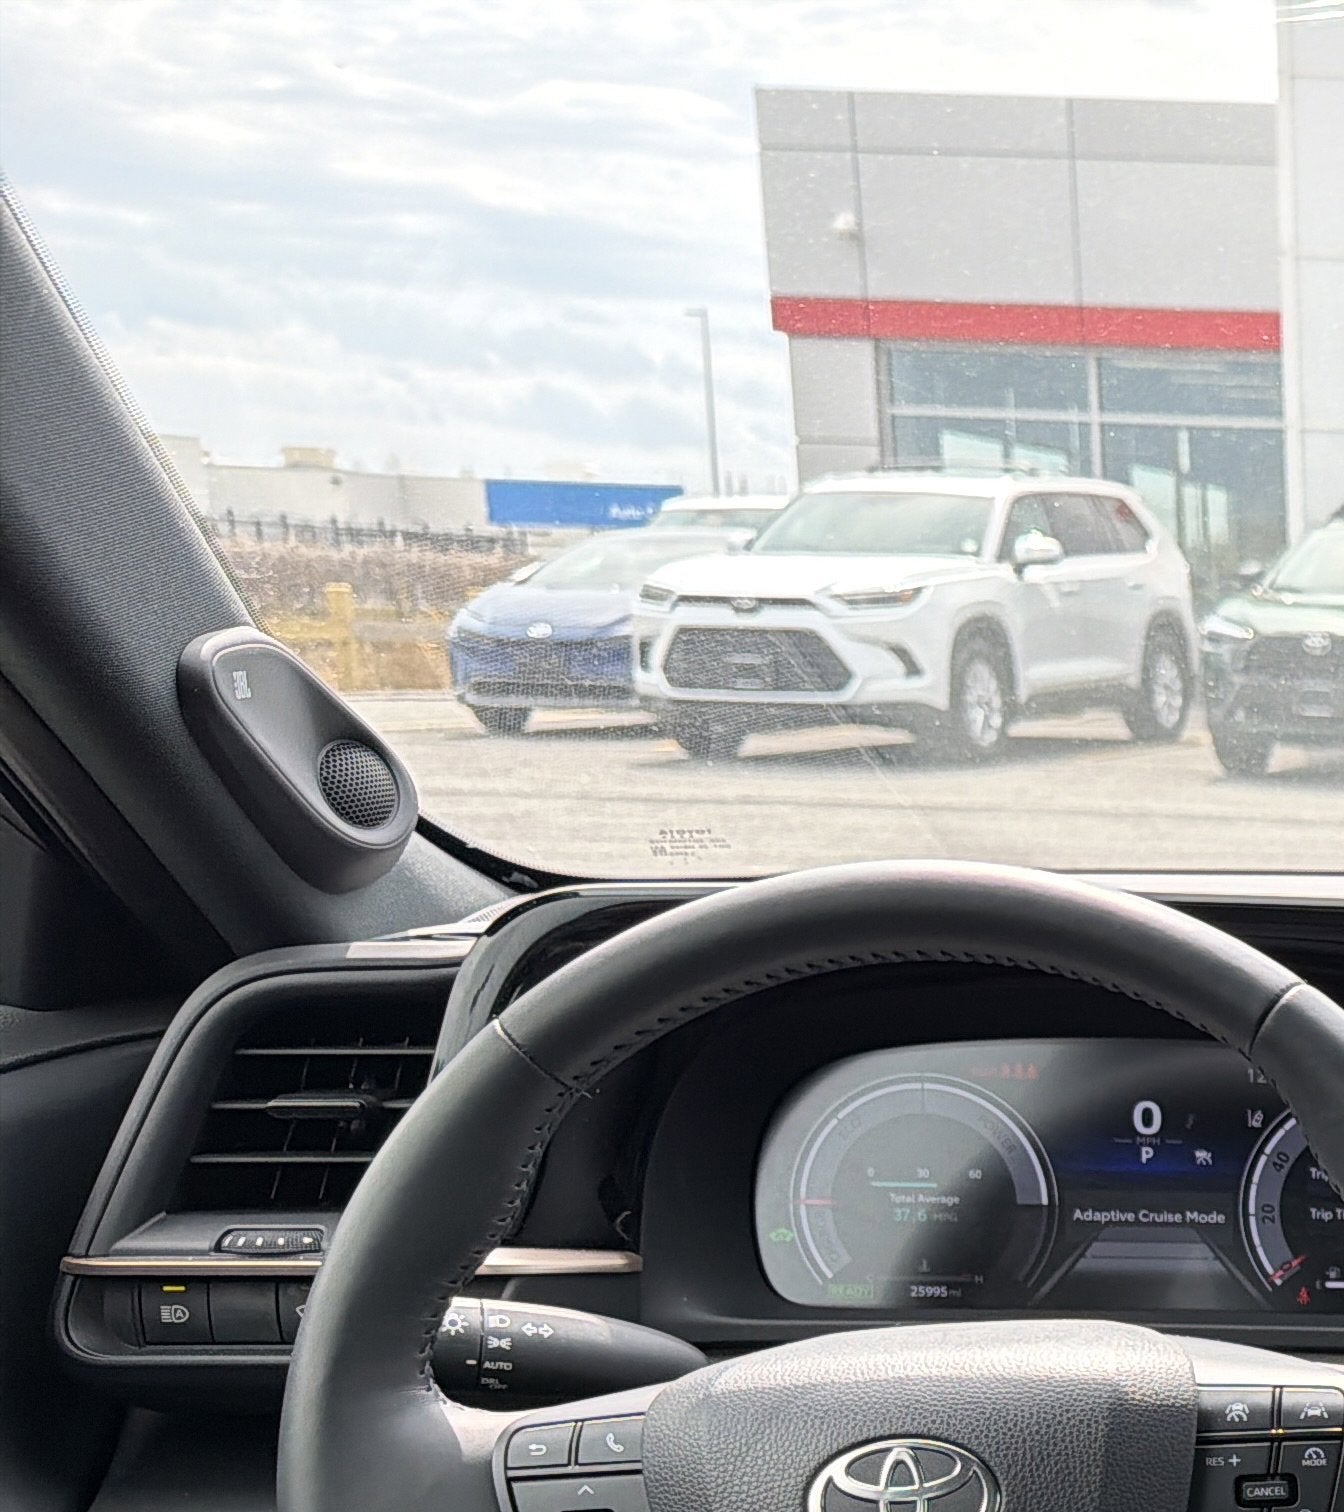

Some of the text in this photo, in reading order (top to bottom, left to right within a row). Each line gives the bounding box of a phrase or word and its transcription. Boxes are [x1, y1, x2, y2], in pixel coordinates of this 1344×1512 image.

[232, 670, 252, 700] JBL
[1133, 1101, 1162, 1135] 0
[1141, 1147, 1154, 1164] P
[1271, 1151, 1291, 1175] 40
[1073, 1208, 1226, 1224] Adaptive Cruise Mode
[1261, 1203, 1276, 1225] 20
[1309, 1208, 1334, 1223] Trip
[910, 1286, 948, 1298] 25995
[483, 1360, 513, 1371] AUTO
[1206, 1456, 1225, 1467] RES
[1302, 1457, 1328, 1467] MODE
[1246, 1486, 1287, 1498] CANCEL
